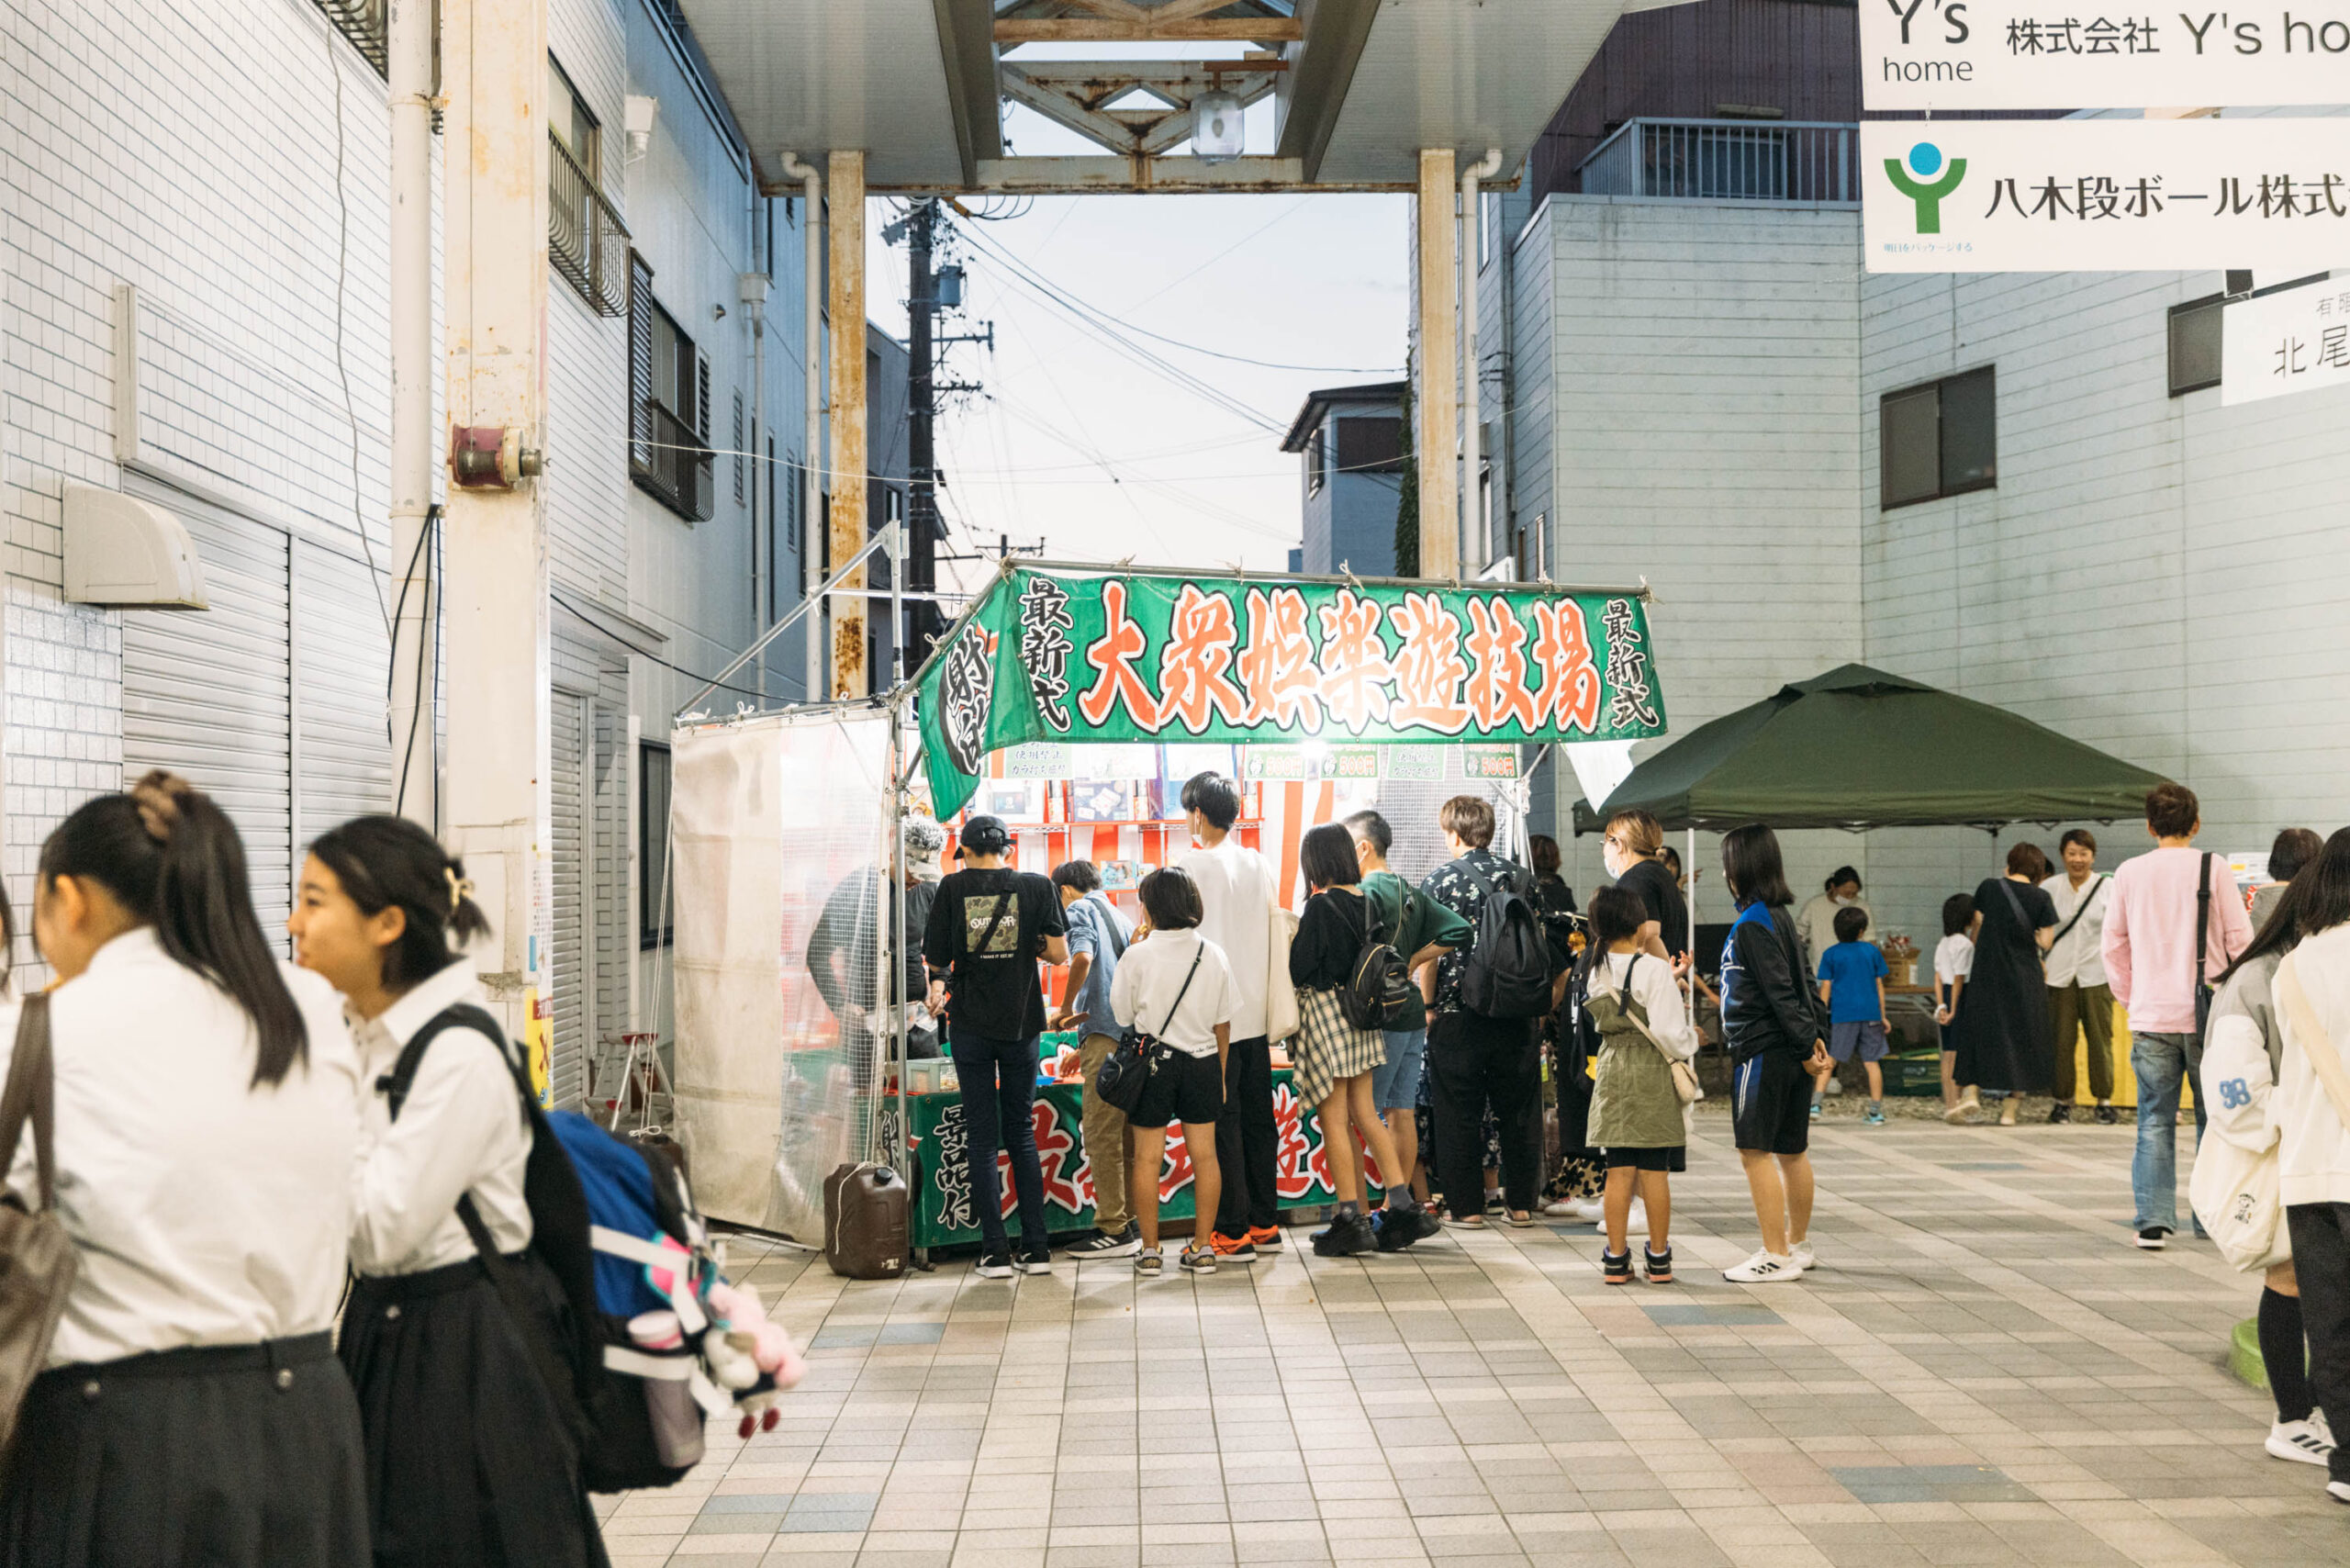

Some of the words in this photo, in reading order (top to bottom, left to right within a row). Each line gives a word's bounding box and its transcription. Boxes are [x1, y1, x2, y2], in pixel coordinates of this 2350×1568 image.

[2007, 17, 2160, 57] 株式会社
[2178, 13, 2263, 55] Y's
[1883, 57, 1974, 82] home
[1985, 174, 2350, 220] 八木段ボール株式
[2274, 324, 2350, 378] 北尾
[1019, 577, 1073, 733] 最新式
[1079, 579, 1604, 735] 大衆娯楽遊技場
[1604, 599, 1658, 729] 最新式
[1339, 755, 1376, 776] 500円
[1482, 756, 1515, 777] 500円
